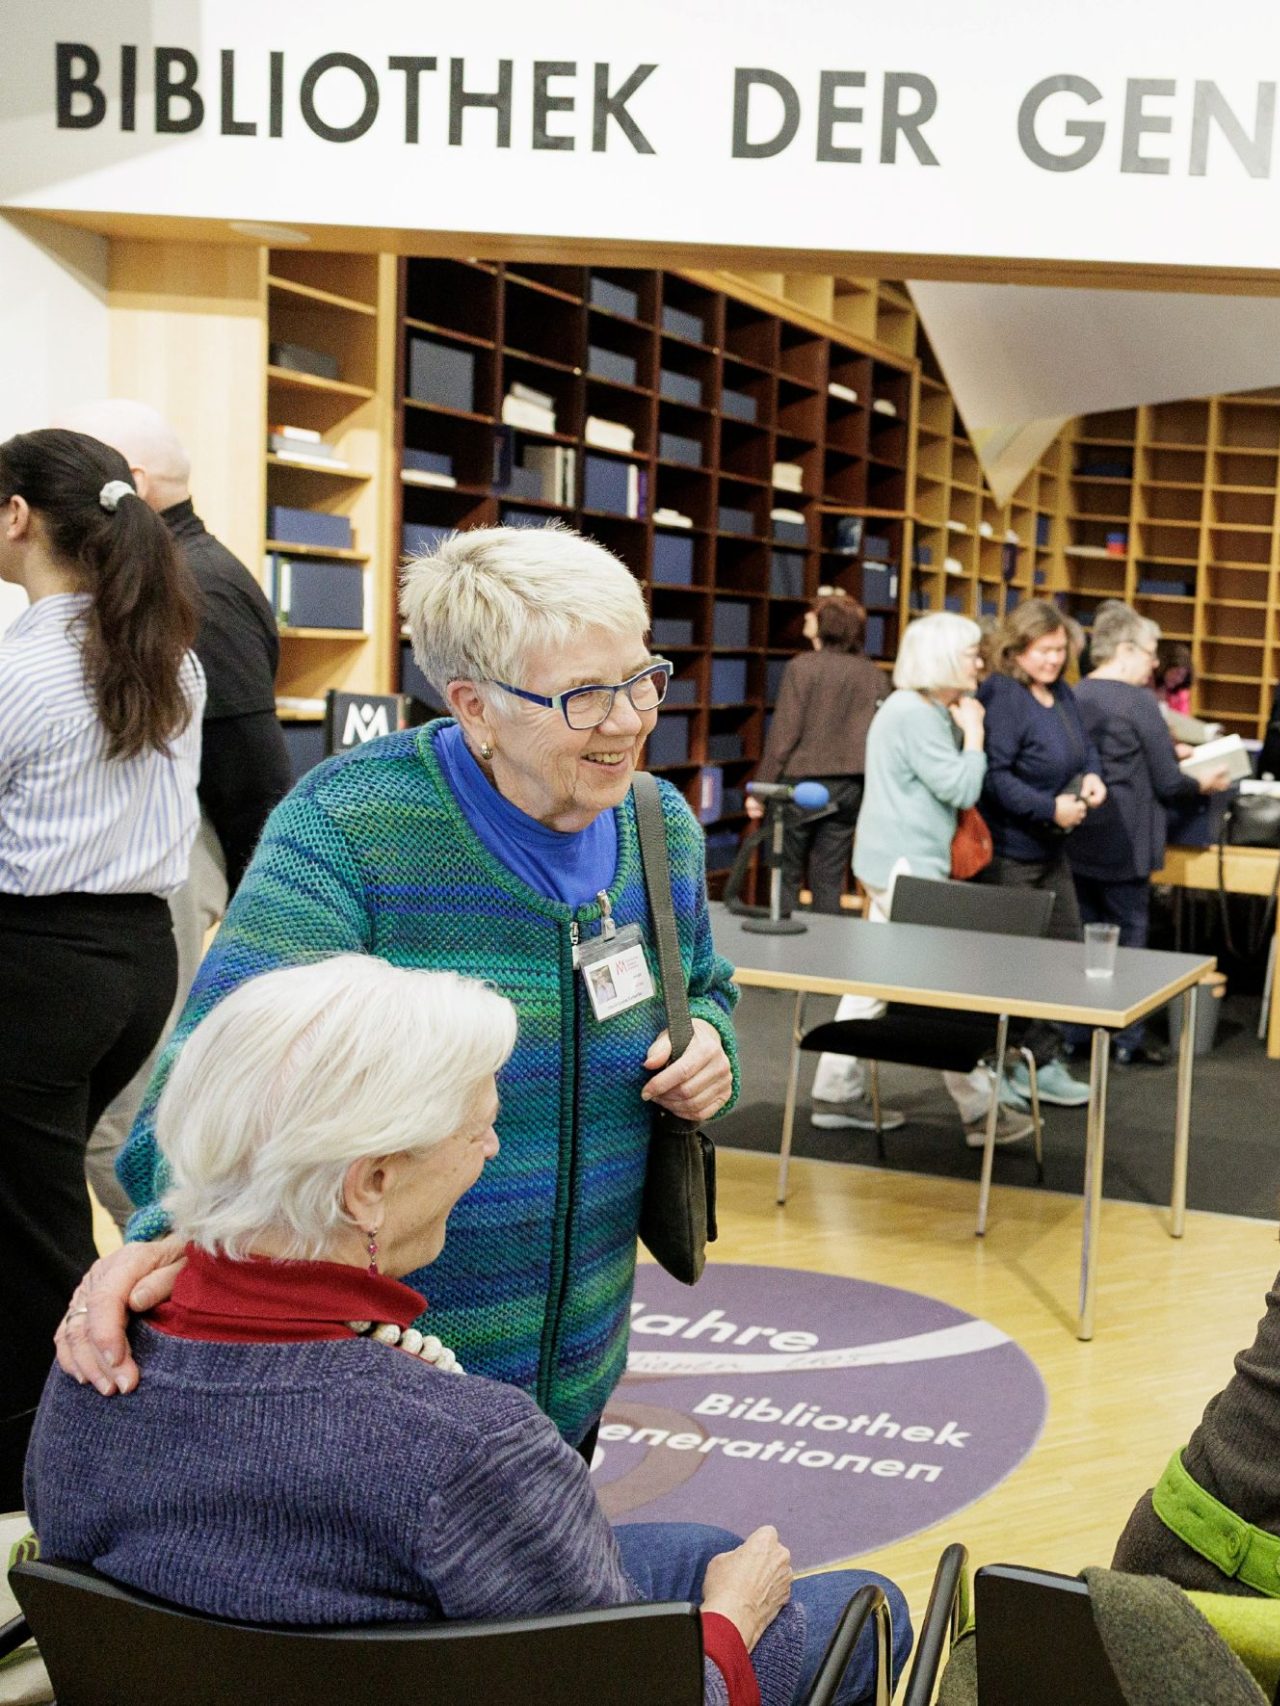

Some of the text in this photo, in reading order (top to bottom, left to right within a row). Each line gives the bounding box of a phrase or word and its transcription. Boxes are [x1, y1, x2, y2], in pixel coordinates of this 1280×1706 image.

[54, 41, 658, 154] BIBLIOTHEK
[732, 68, 940, 165] DER
[693, 1394, 972, 1449] Bibliothek
[597, 1422, 943, 1483] enerationen
